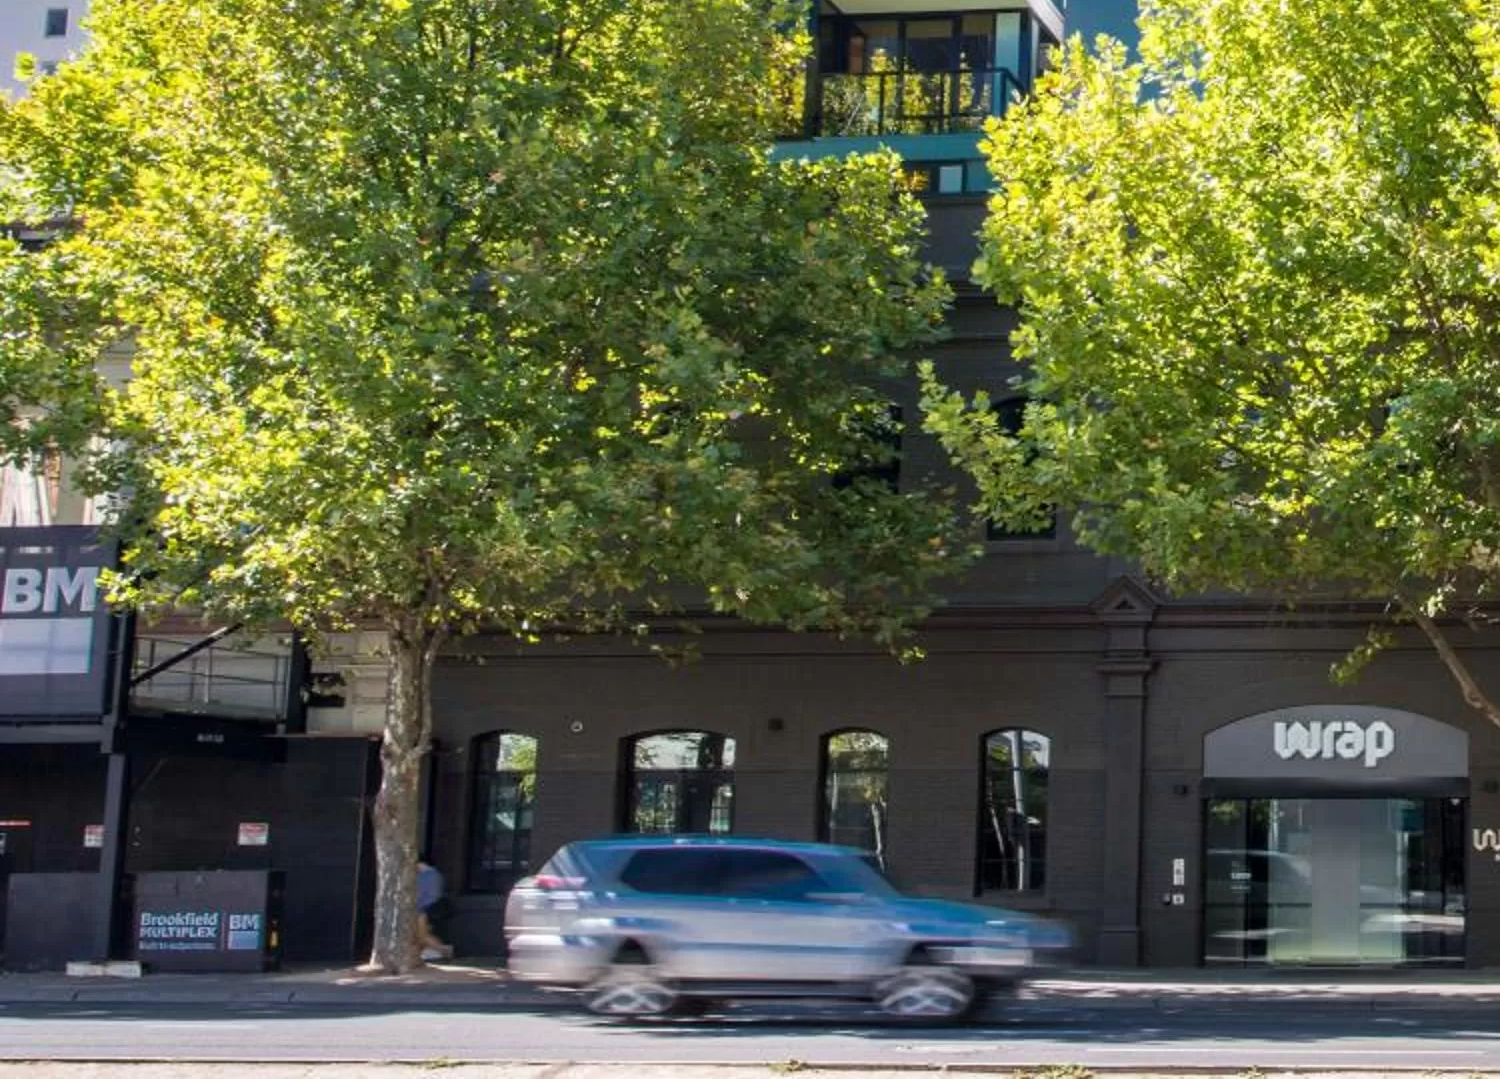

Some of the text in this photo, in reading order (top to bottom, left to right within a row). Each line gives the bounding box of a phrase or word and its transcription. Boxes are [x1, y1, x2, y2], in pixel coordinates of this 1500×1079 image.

[2, 566, 99, 613] BM
[1274, 720, 1394, 767] wrap
[140, 912, 219, 926] Brookfield
[229, 914, 259, 930] BM
[139, 926, 217, 938] MULTIPLEX
